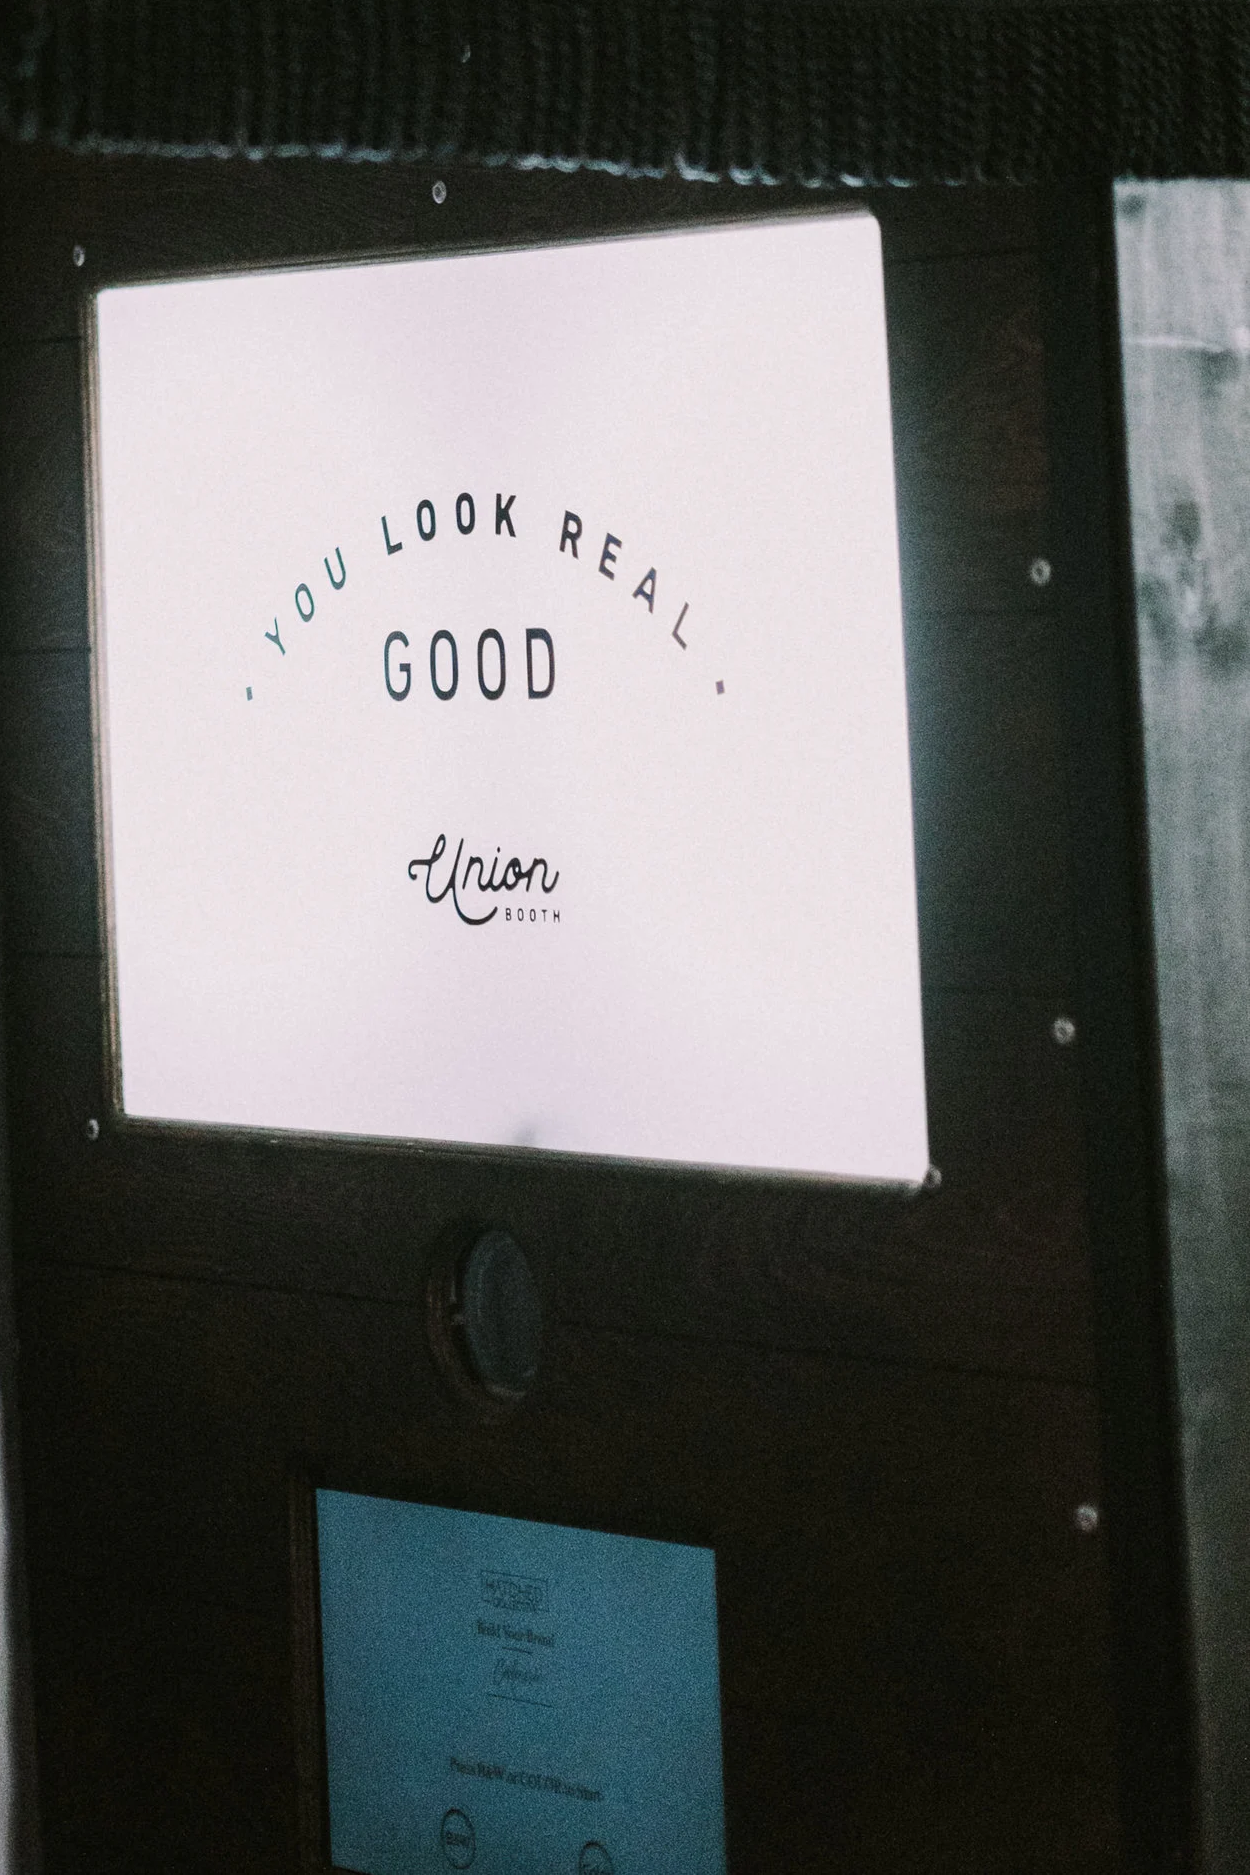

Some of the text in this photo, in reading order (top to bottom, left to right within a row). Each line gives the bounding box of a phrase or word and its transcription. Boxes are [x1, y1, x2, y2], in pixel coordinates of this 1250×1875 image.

[262, 490, 691, 658] YOU LOOK REAL
[382, 626, 557, 703] GOOD
[406, 832, 561, 927] Union
[504, 906, 562, 924] BOOTH
